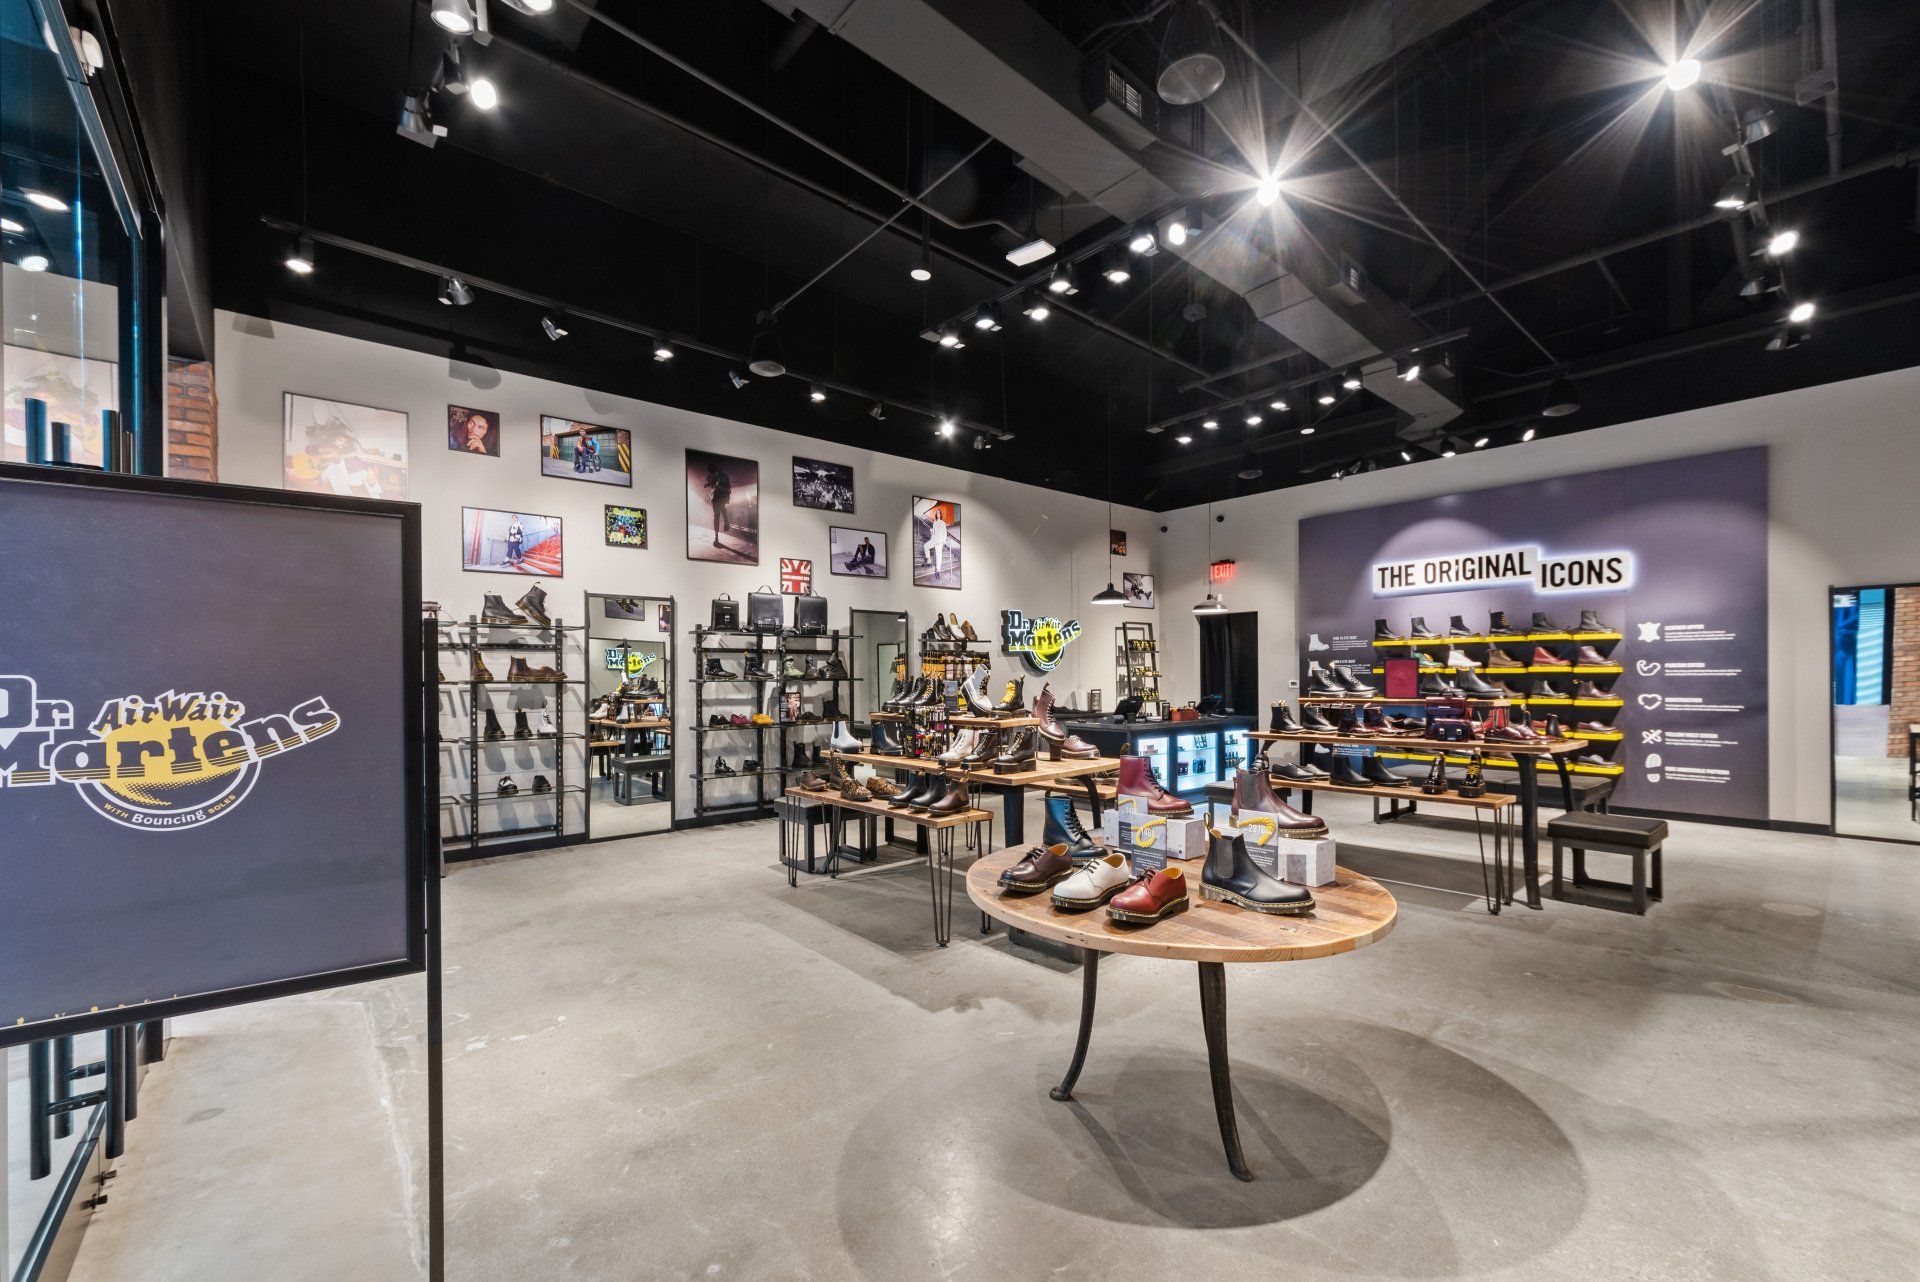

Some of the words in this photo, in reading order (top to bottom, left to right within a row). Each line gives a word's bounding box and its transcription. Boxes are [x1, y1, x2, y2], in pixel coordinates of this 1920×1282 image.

[1214, 564, 1231, 578] EXIT
[1378, 564, 1415, 589] THE
[1424, 551, 1532, 584] ORIGINAL
[1541, 557, 1623, 588] ICONS
[1009, 620, 1082, 652] Martens
[88, 689, 246, 738] AirWair
[103, 802, 129, 818] WITH
[131, 809, 207, 826] Bouncing
[207, 794, 237, 815] SOLES
